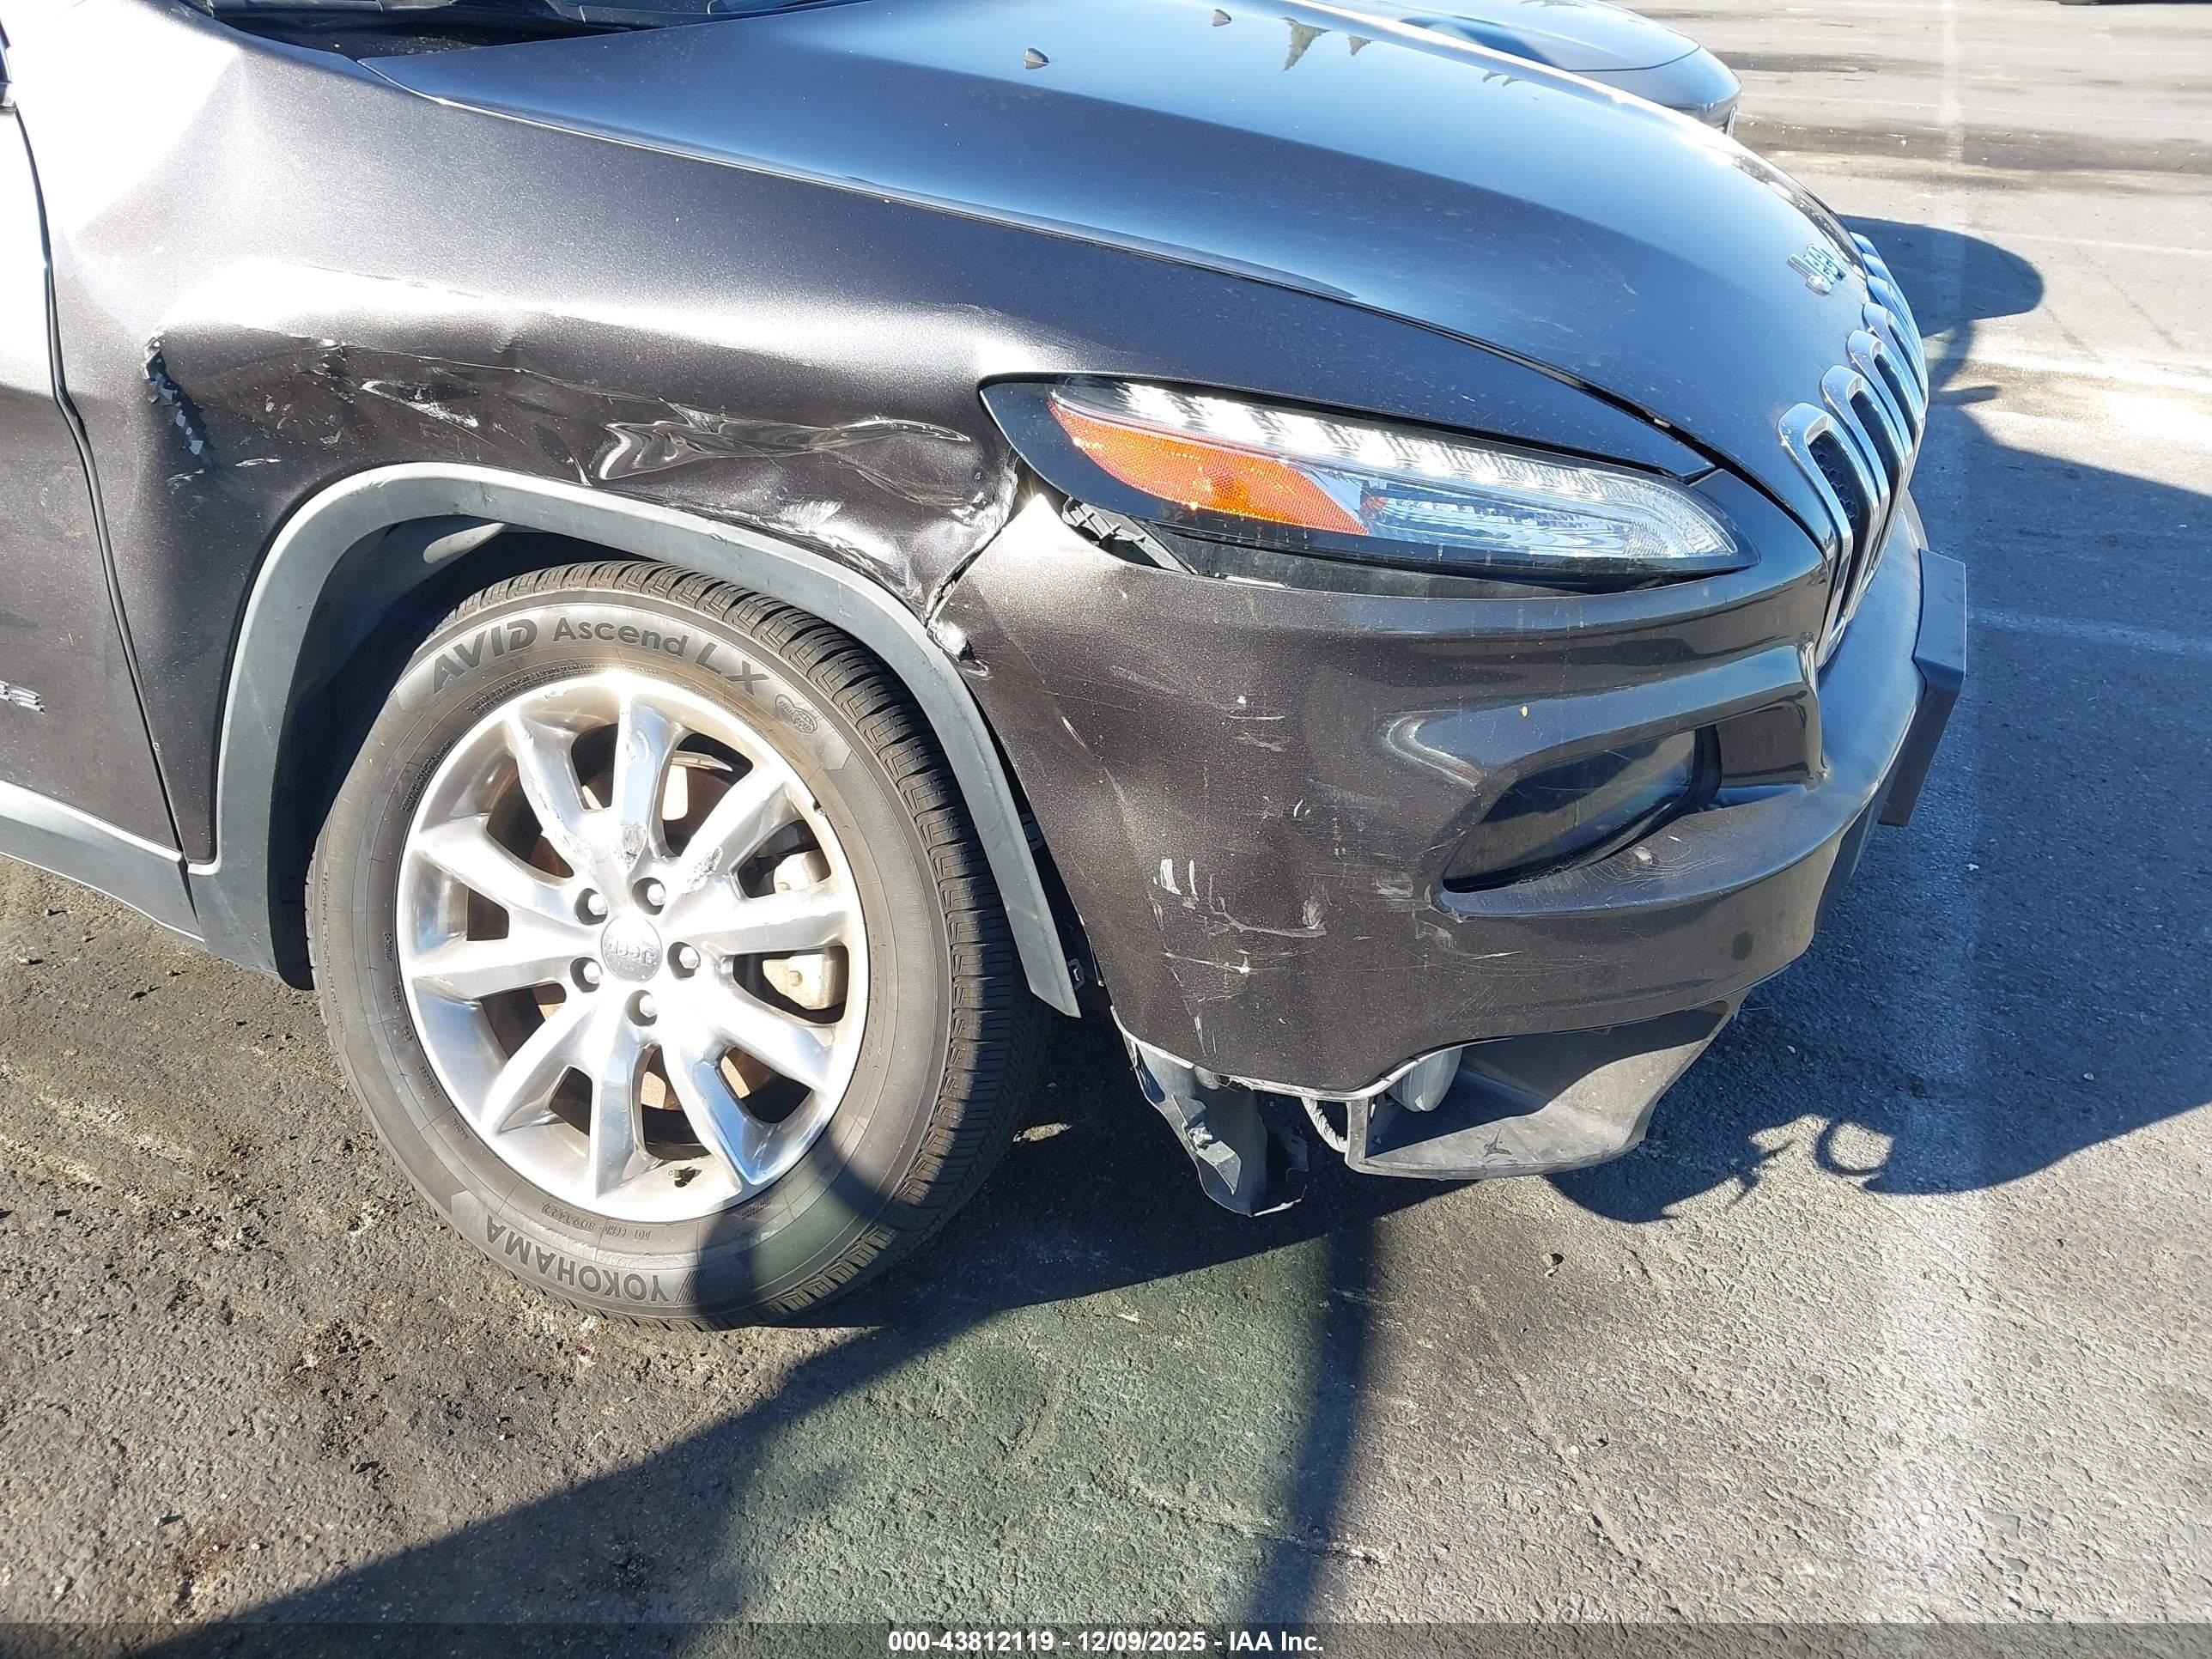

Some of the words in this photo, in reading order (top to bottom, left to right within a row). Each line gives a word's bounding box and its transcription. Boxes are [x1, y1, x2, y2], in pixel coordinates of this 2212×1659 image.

[433, 618, 538, 694] AVID
[553, 617, 689, 657] Ascend
[418, 1066, 440, 1099] TUBELESS
[451, 1117, 470, 1140] RADIAL
[486, 1214, 670, 1302] YOKOHAMA
